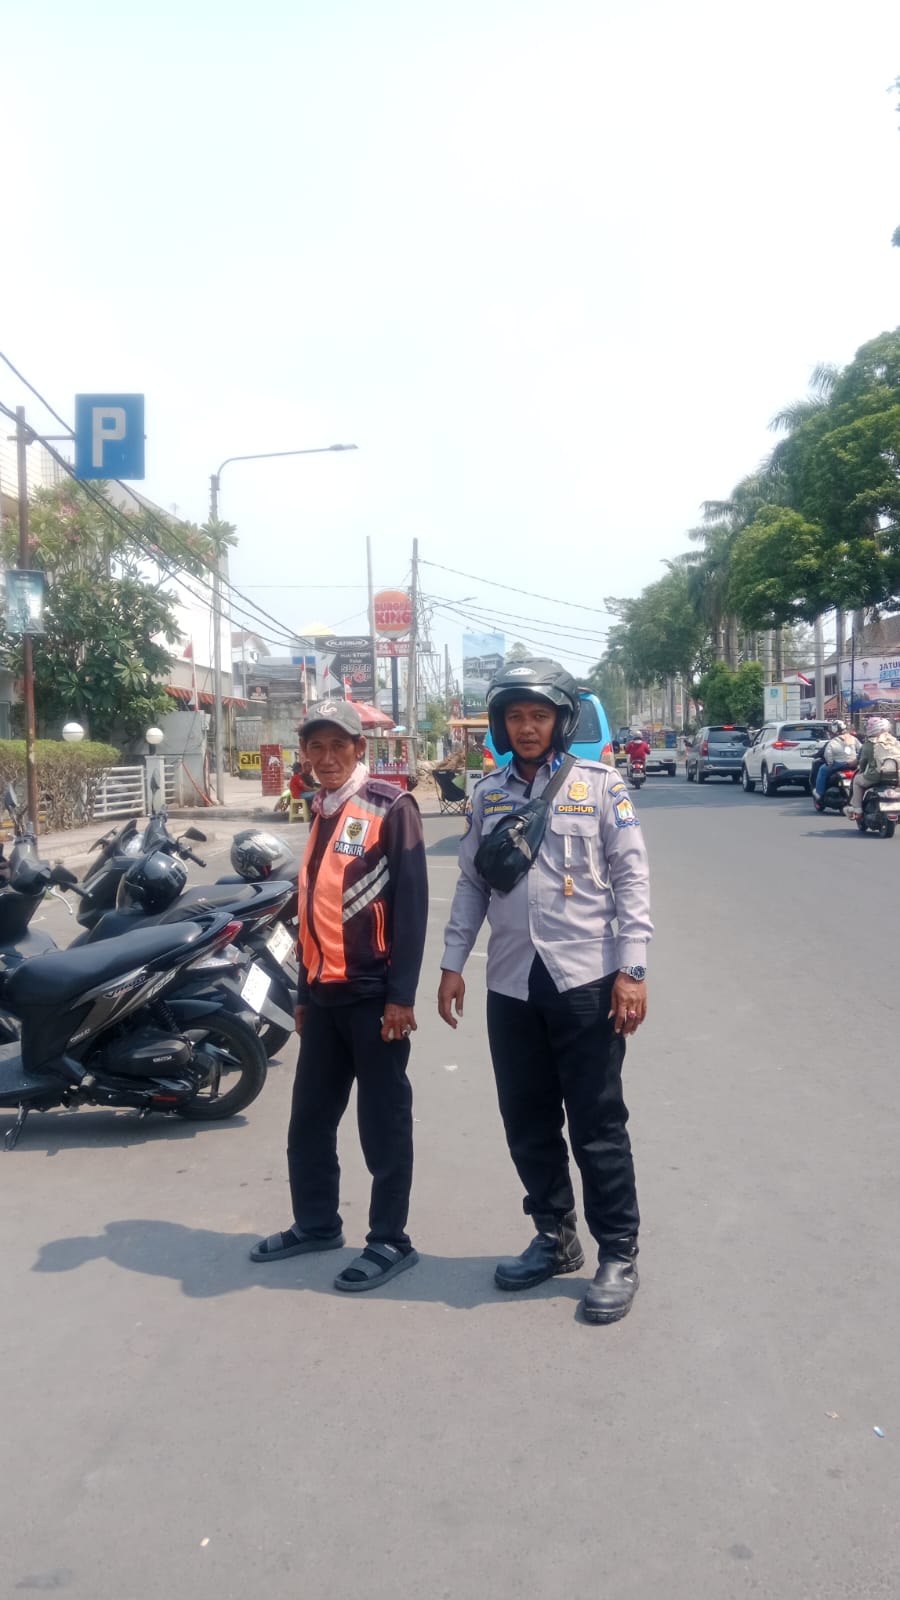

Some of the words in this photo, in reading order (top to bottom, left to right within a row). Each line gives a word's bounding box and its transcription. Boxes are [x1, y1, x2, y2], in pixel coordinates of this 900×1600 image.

[92, 406, 126, 468] P
[375, 610, 411, 624] KING
[880, 661, 900, 671] JATU
[558, 804, 594, 813] DISHUB
[334, 842, 363, 857] PARKIR
